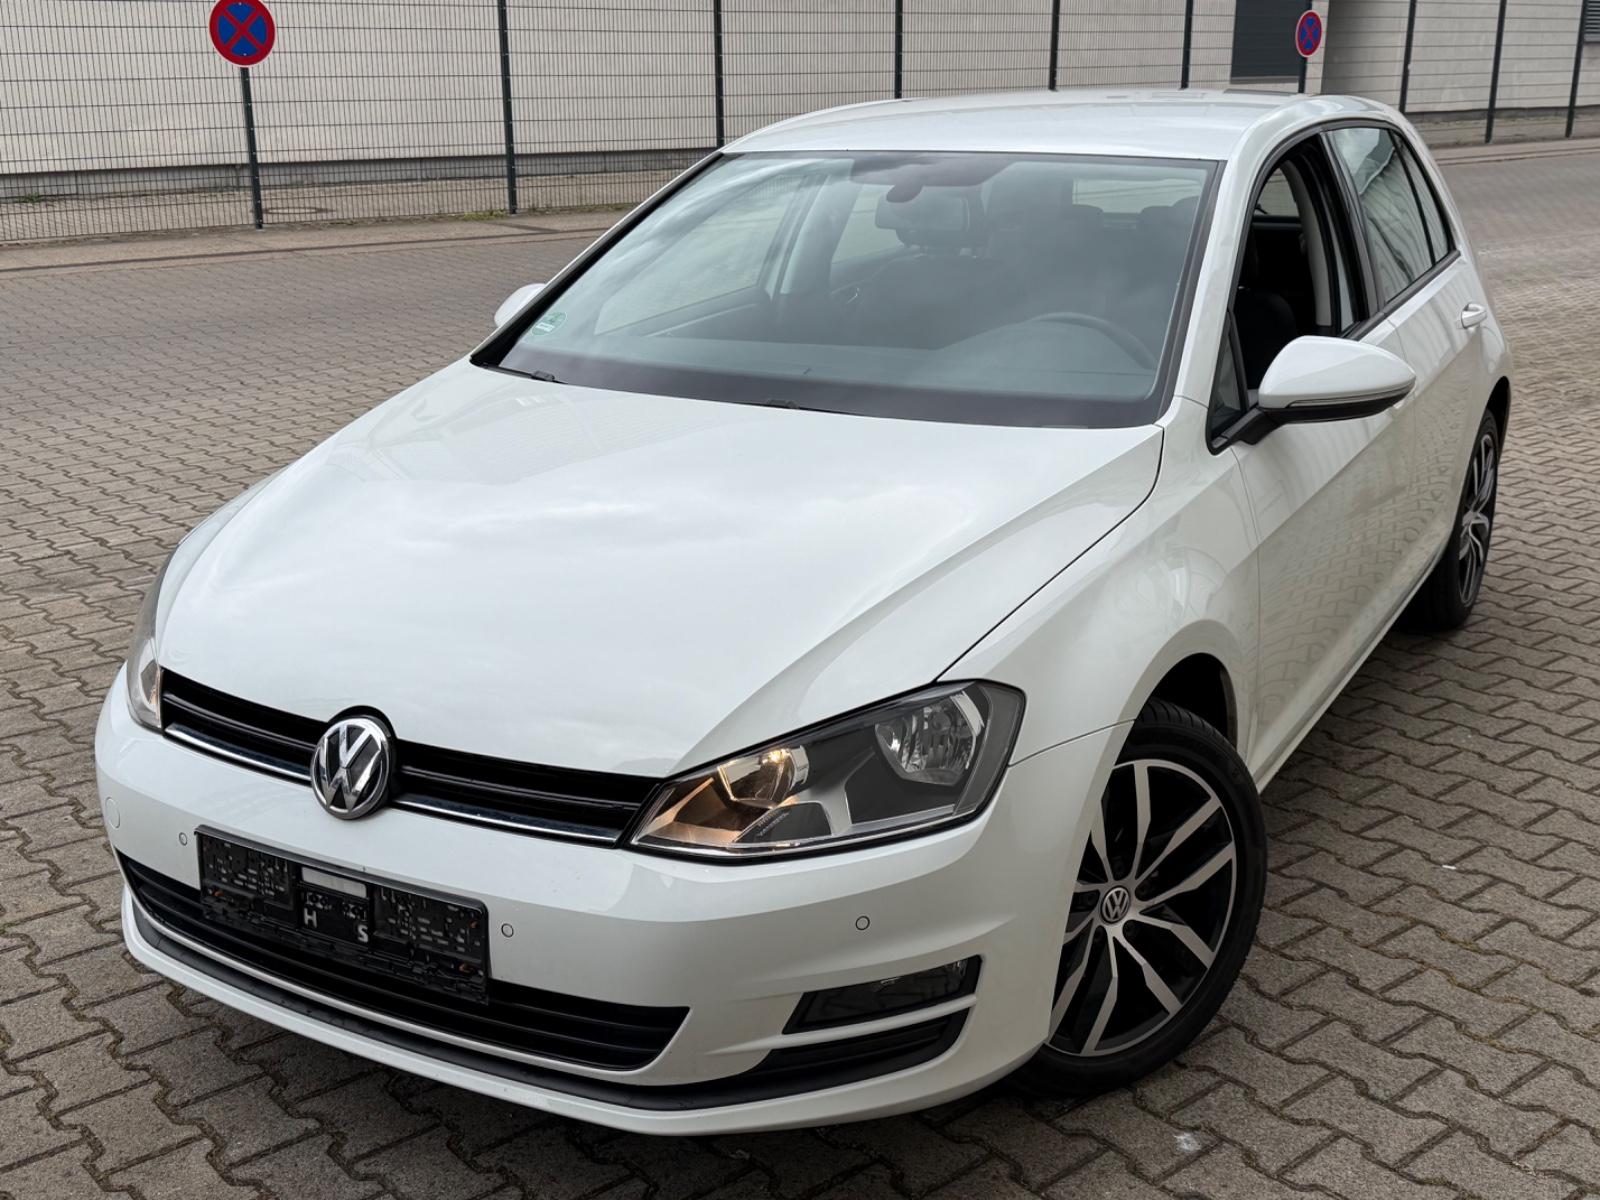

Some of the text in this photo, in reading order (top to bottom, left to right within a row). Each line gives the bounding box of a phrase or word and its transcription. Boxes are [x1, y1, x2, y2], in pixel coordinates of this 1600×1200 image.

[315, 717, 388, 816] VW
[1103, 887, 1129, 921] VW
[303, 907, 369, 943] H S
